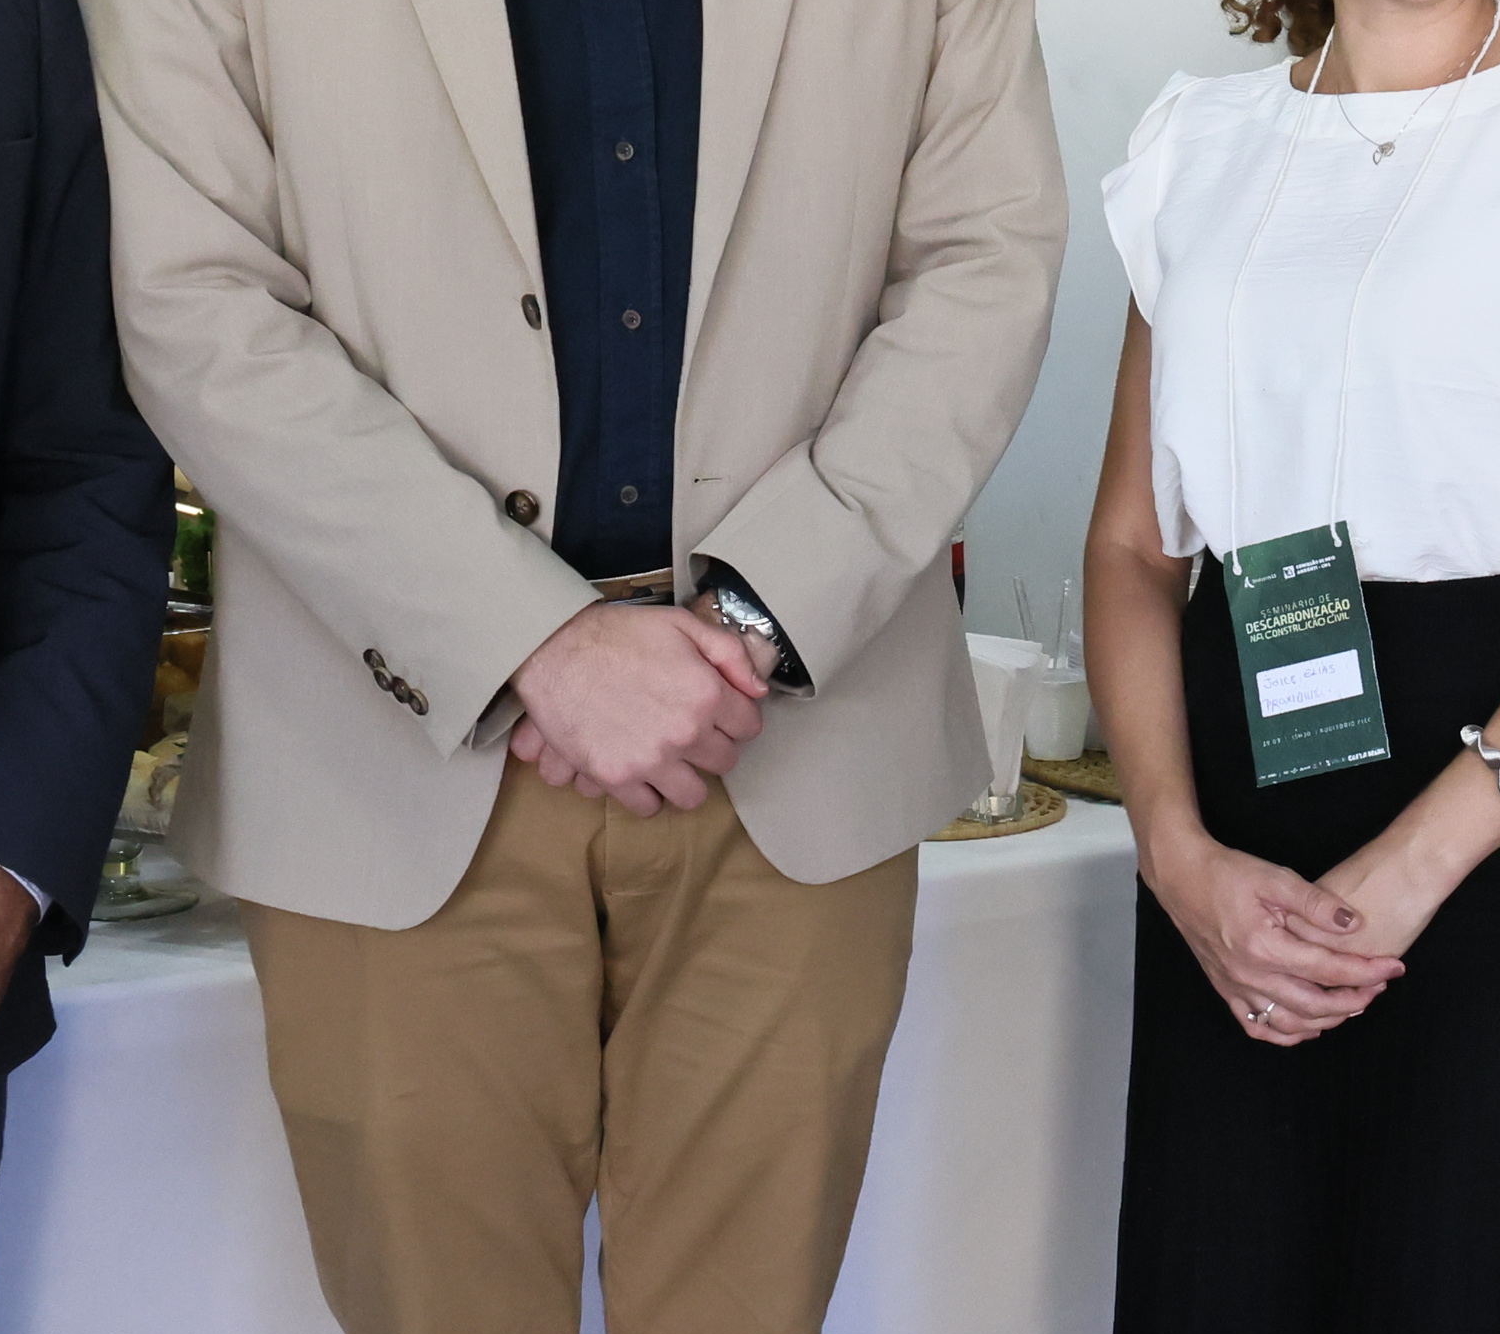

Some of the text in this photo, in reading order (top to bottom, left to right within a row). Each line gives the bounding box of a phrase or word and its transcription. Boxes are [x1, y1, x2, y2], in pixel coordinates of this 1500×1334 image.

[1318, 593, 1332, 605] DE
[1245, 598, 1351, 635] DESCARBONIZAÇÃO
[1250, 633, 1264, 644] NA
[1327, 611, 1350, 625] CIVIL
